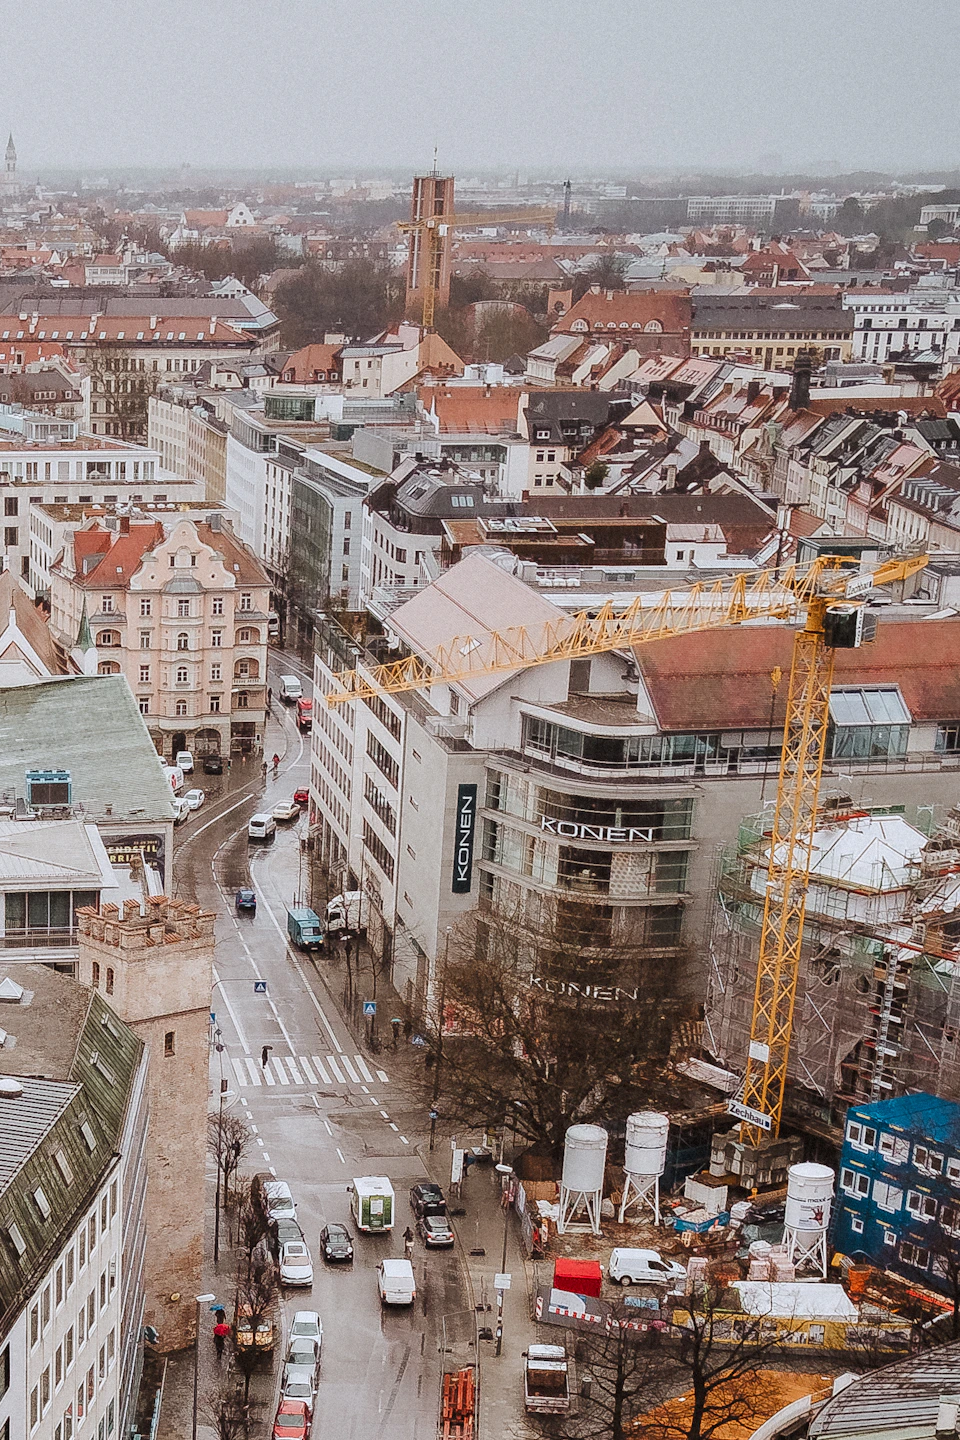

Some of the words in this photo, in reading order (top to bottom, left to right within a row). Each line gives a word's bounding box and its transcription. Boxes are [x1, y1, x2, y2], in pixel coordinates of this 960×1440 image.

[456, 796, 473, 881] KONEN
[541, 816, 653, 842] KONEN
[730, 1102, 764, 1126] Zechbau
